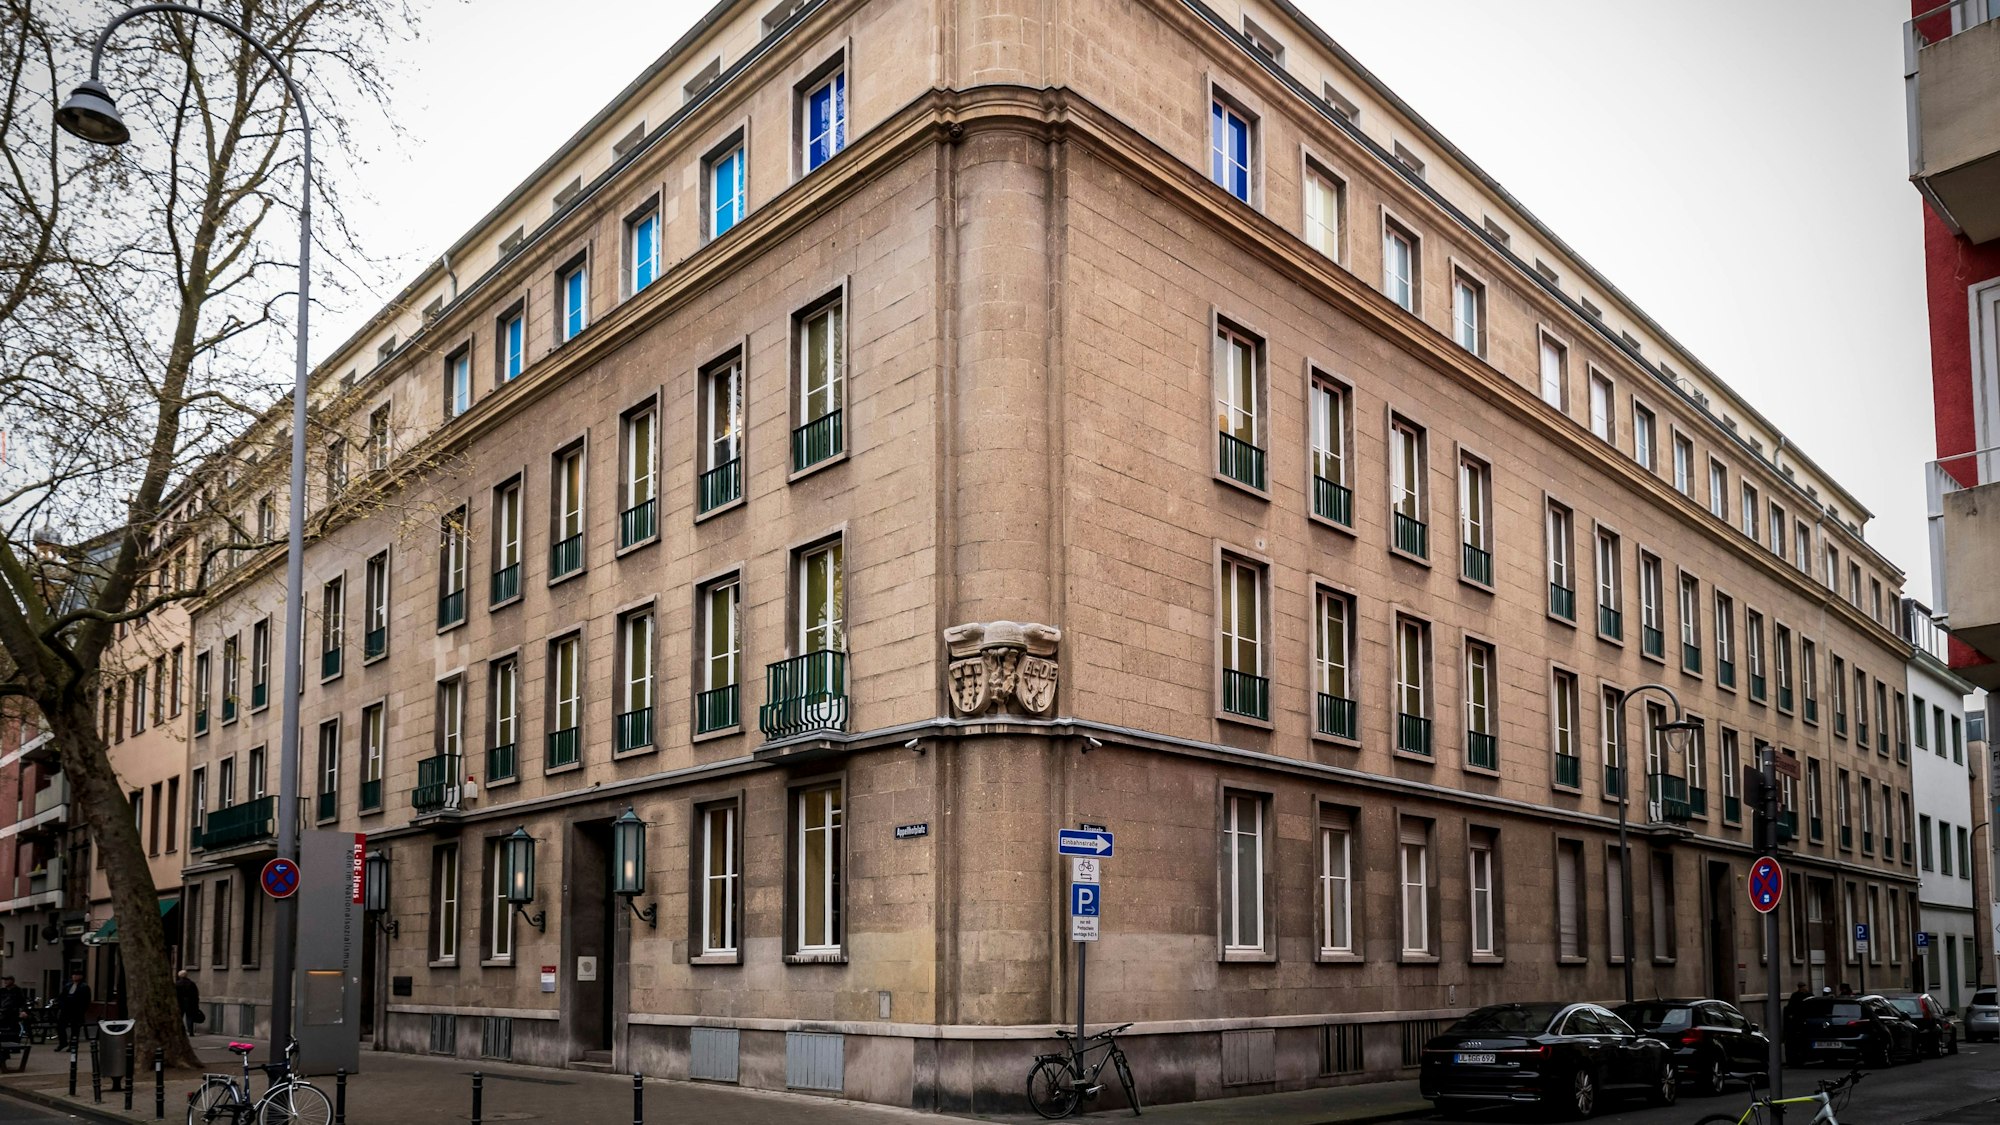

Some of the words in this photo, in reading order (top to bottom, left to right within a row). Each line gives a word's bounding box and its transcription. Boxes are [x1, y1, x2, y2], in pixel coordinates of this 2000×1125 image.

[1062, 838, 1098, 847] Einbahnstraße
[346, 870, 353, 881] im
[1078, 888, 1094, 914] P
[343, 884, 353, 969] Nationalsozialismus
[1857, 926, 1864, 939] P
[1917, 933, 1925, 945] P
